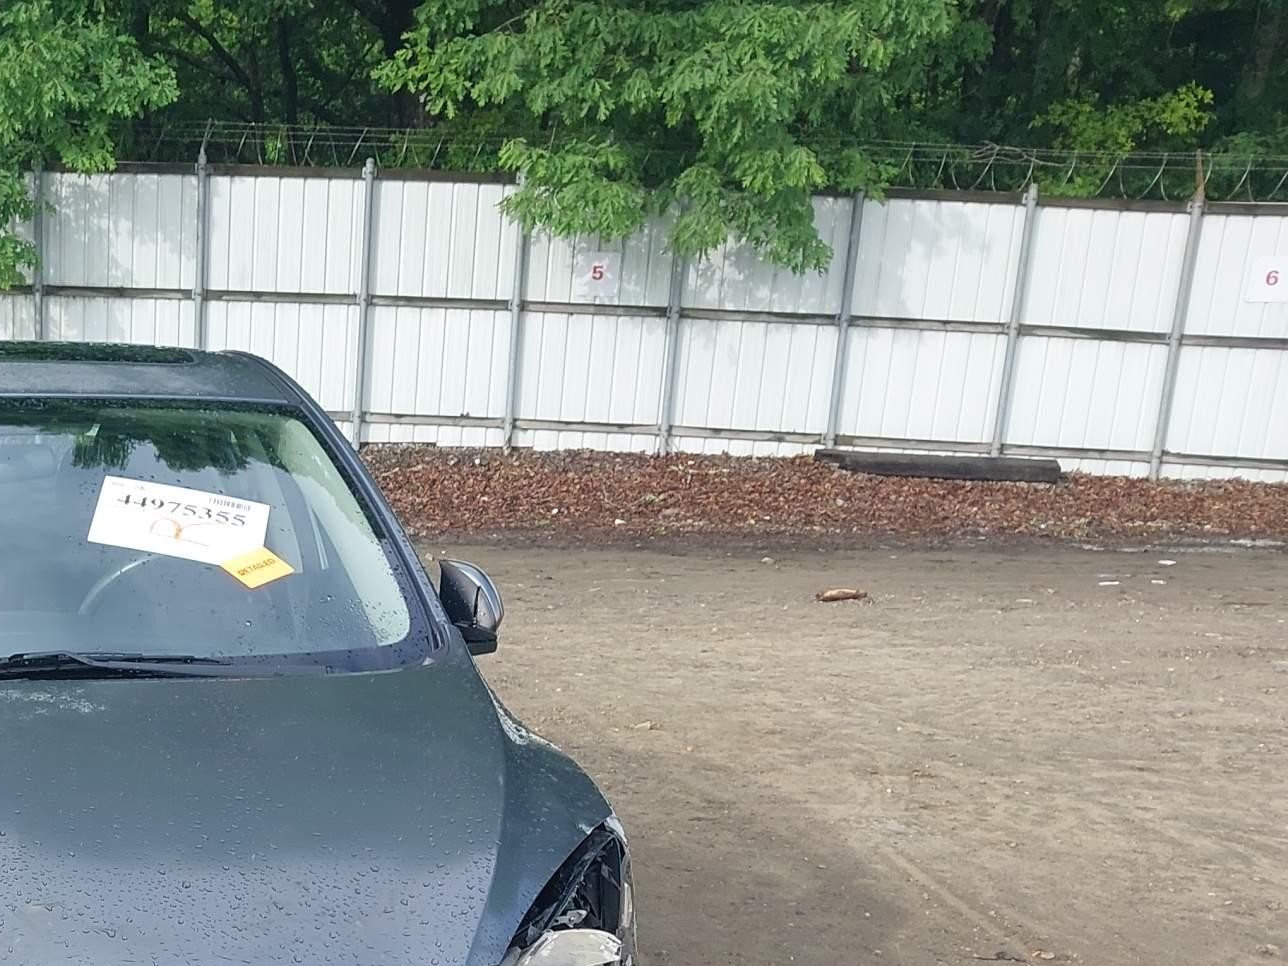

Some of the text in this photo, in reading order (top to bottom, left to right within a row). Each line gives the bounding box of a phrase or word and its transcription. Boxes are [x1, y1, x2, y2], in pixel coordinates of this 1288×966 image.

[591, 264, 605, 281] 5
[1265, 269, 1280, 287] 6
[117, 494, 246, 527] 44975355
